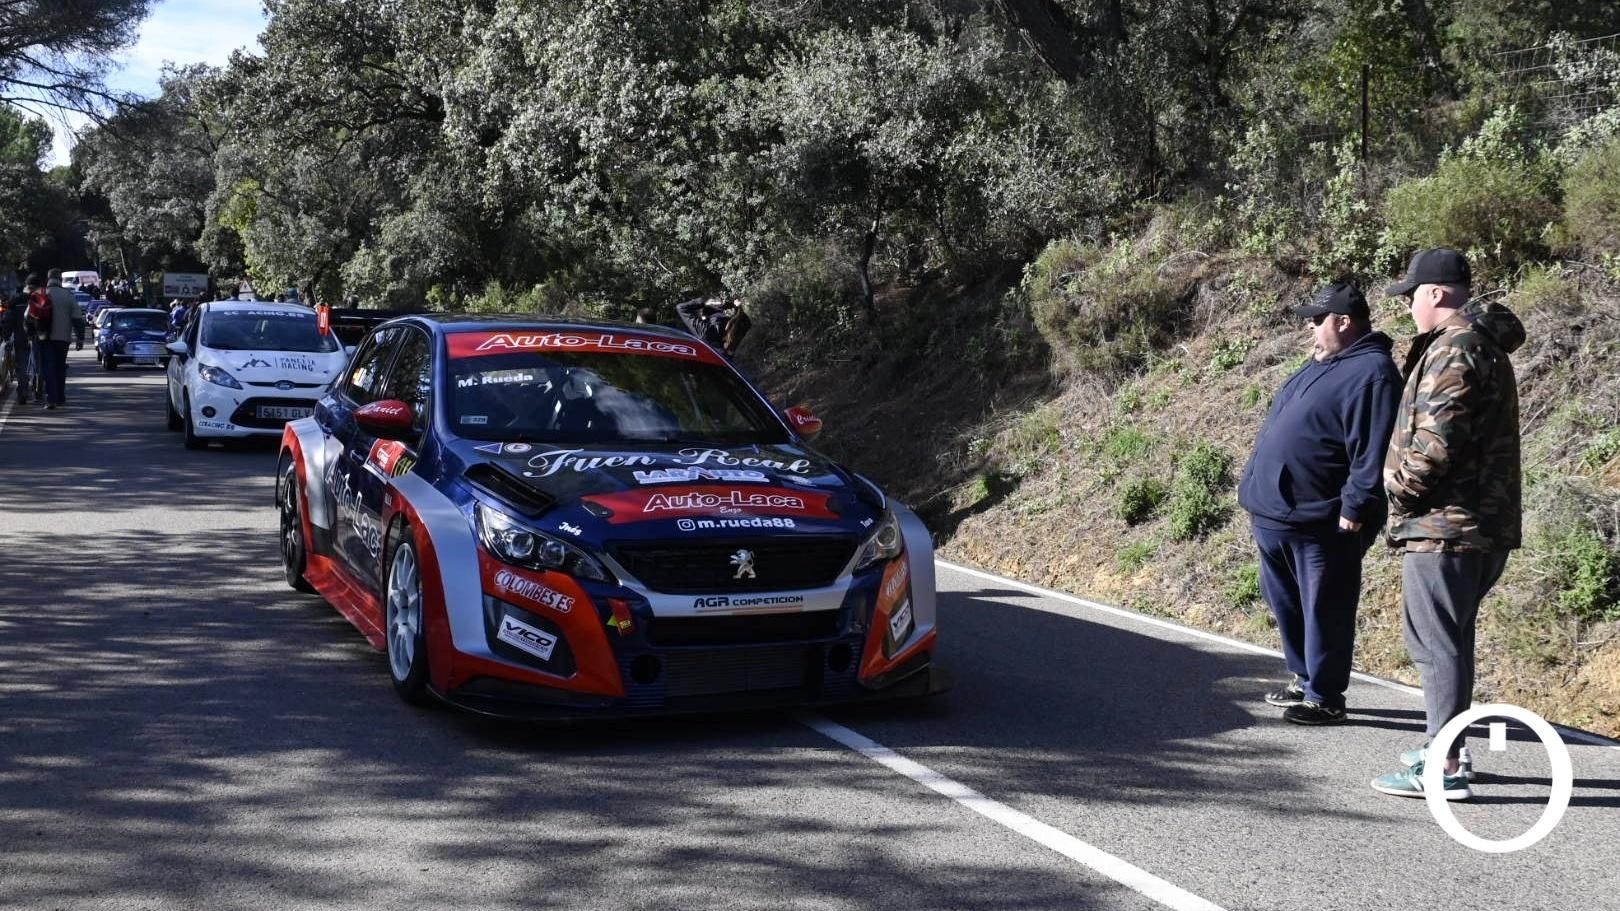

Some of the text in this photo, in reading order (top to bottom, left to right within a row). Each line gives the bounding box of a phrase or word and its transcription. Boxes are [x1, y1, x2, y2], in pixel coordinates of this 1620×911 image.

[475, 333, 697, 356] Auto-Laca
[457, 373, 534, 389] M. Rueda
[522, 447, 810, 478] Fuen Real
[643, 490, 806, 513] Auto-Laca
[697, 517, 796, 529] m.rueda88
[693, 595, 804, 609] AGR COMPETICION
[505, 619, 553, 648] VICO
